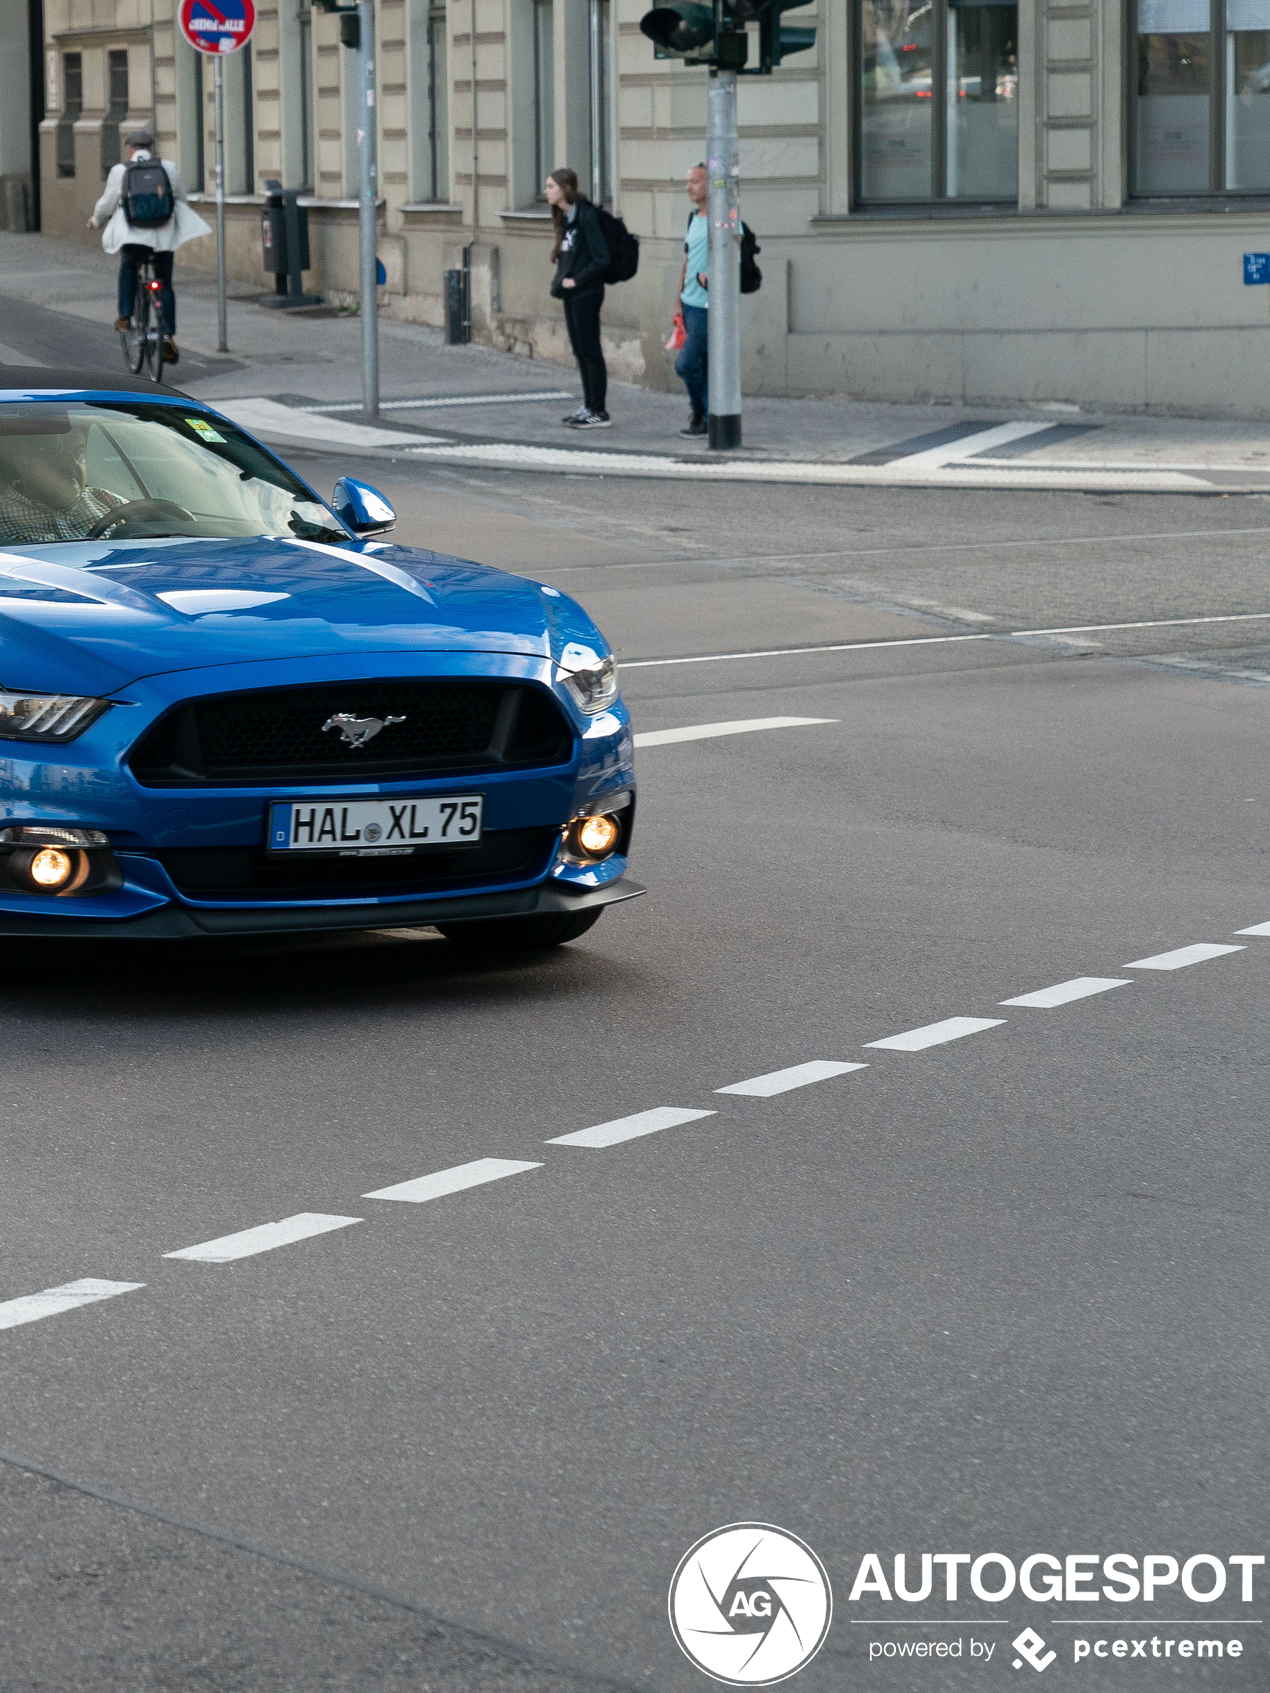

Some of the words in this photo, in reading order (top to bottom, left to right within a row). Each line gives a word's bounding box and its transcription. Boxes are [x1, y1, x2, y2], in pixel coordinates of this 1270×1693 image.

[293, 807, 361, 844] HAL
[385, 804, 430, 840] XL
[439, 801, 480, 837] 75
[276, 831, 285, 842] D
